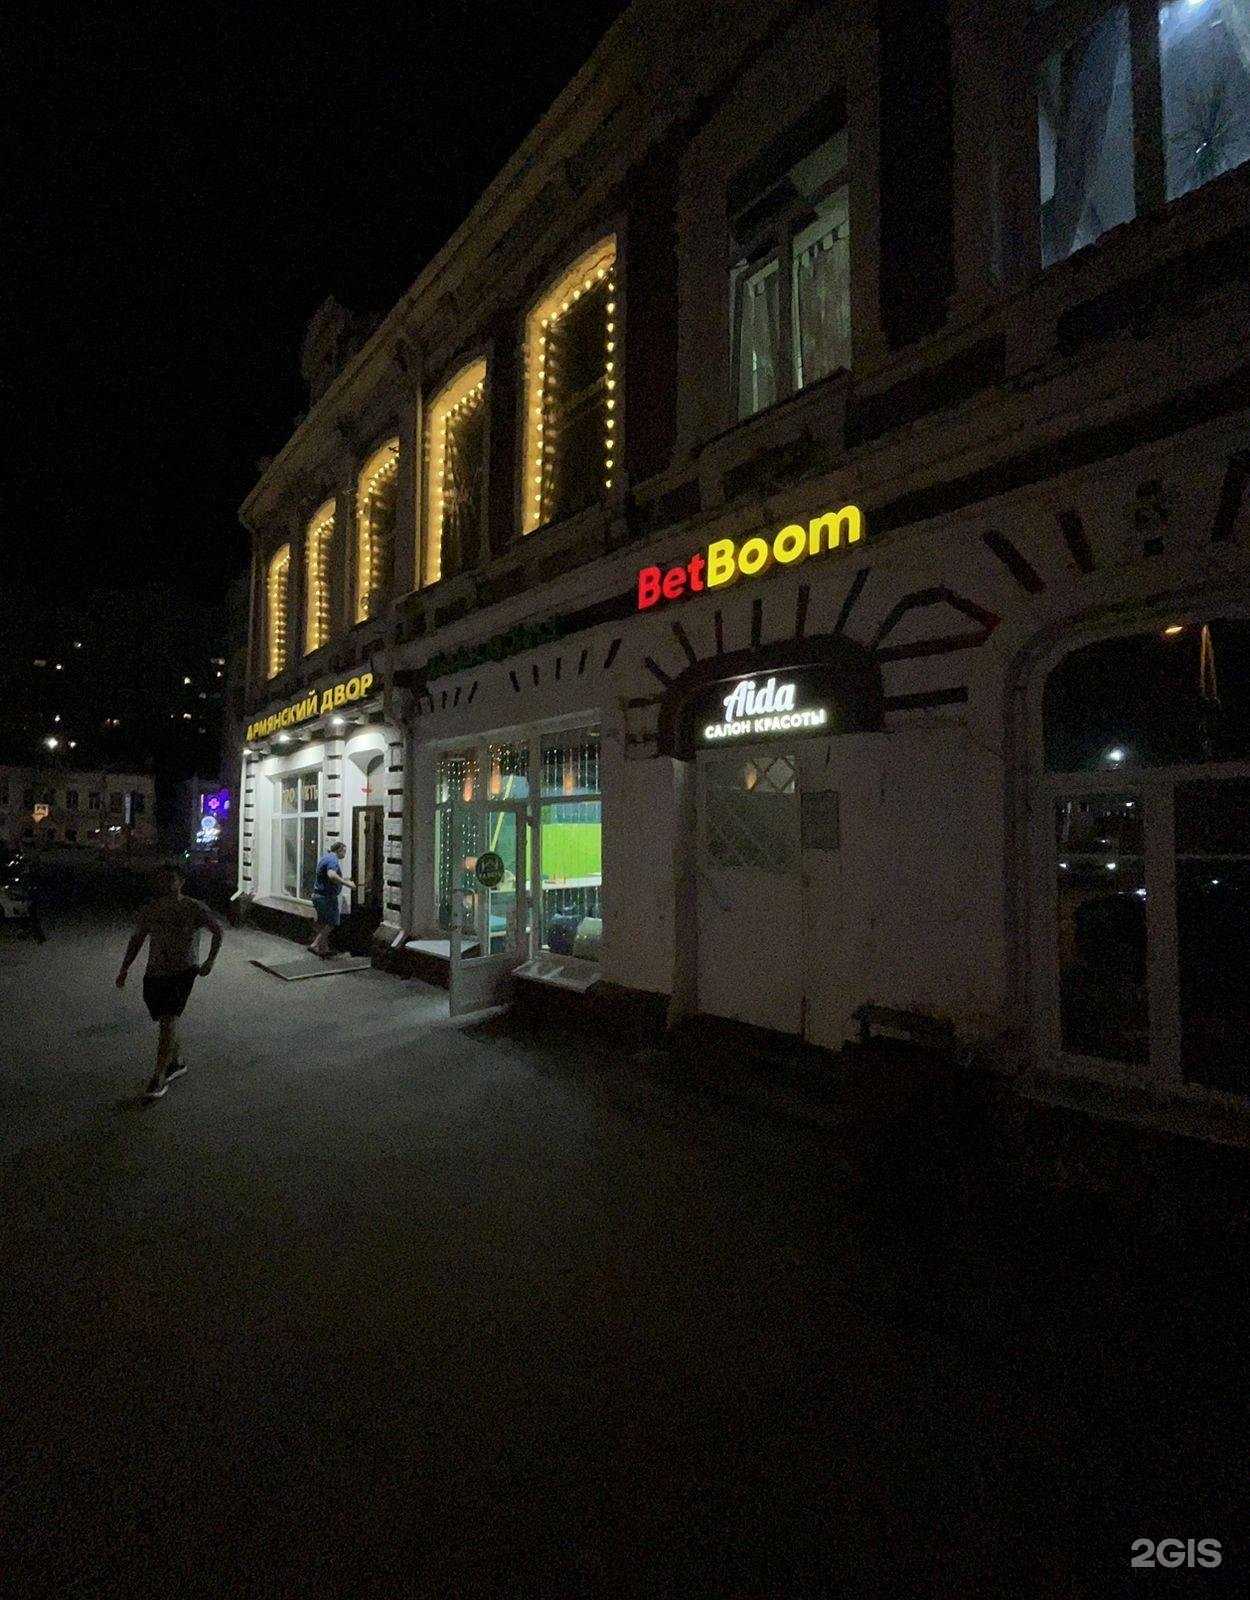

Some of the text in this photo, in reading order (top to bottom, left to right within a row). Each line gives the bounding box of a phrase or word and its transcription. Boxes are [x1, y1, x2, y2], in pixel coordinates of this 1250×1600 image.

[638, 504, 862, 610] BetBoom
[246, 672, 374, 742] АРМЯНСКИЙ ДВОР
[704, 709, 827, 739] САЛОН КРАСОТЫ
[723, 677, 796, 723] Aida
